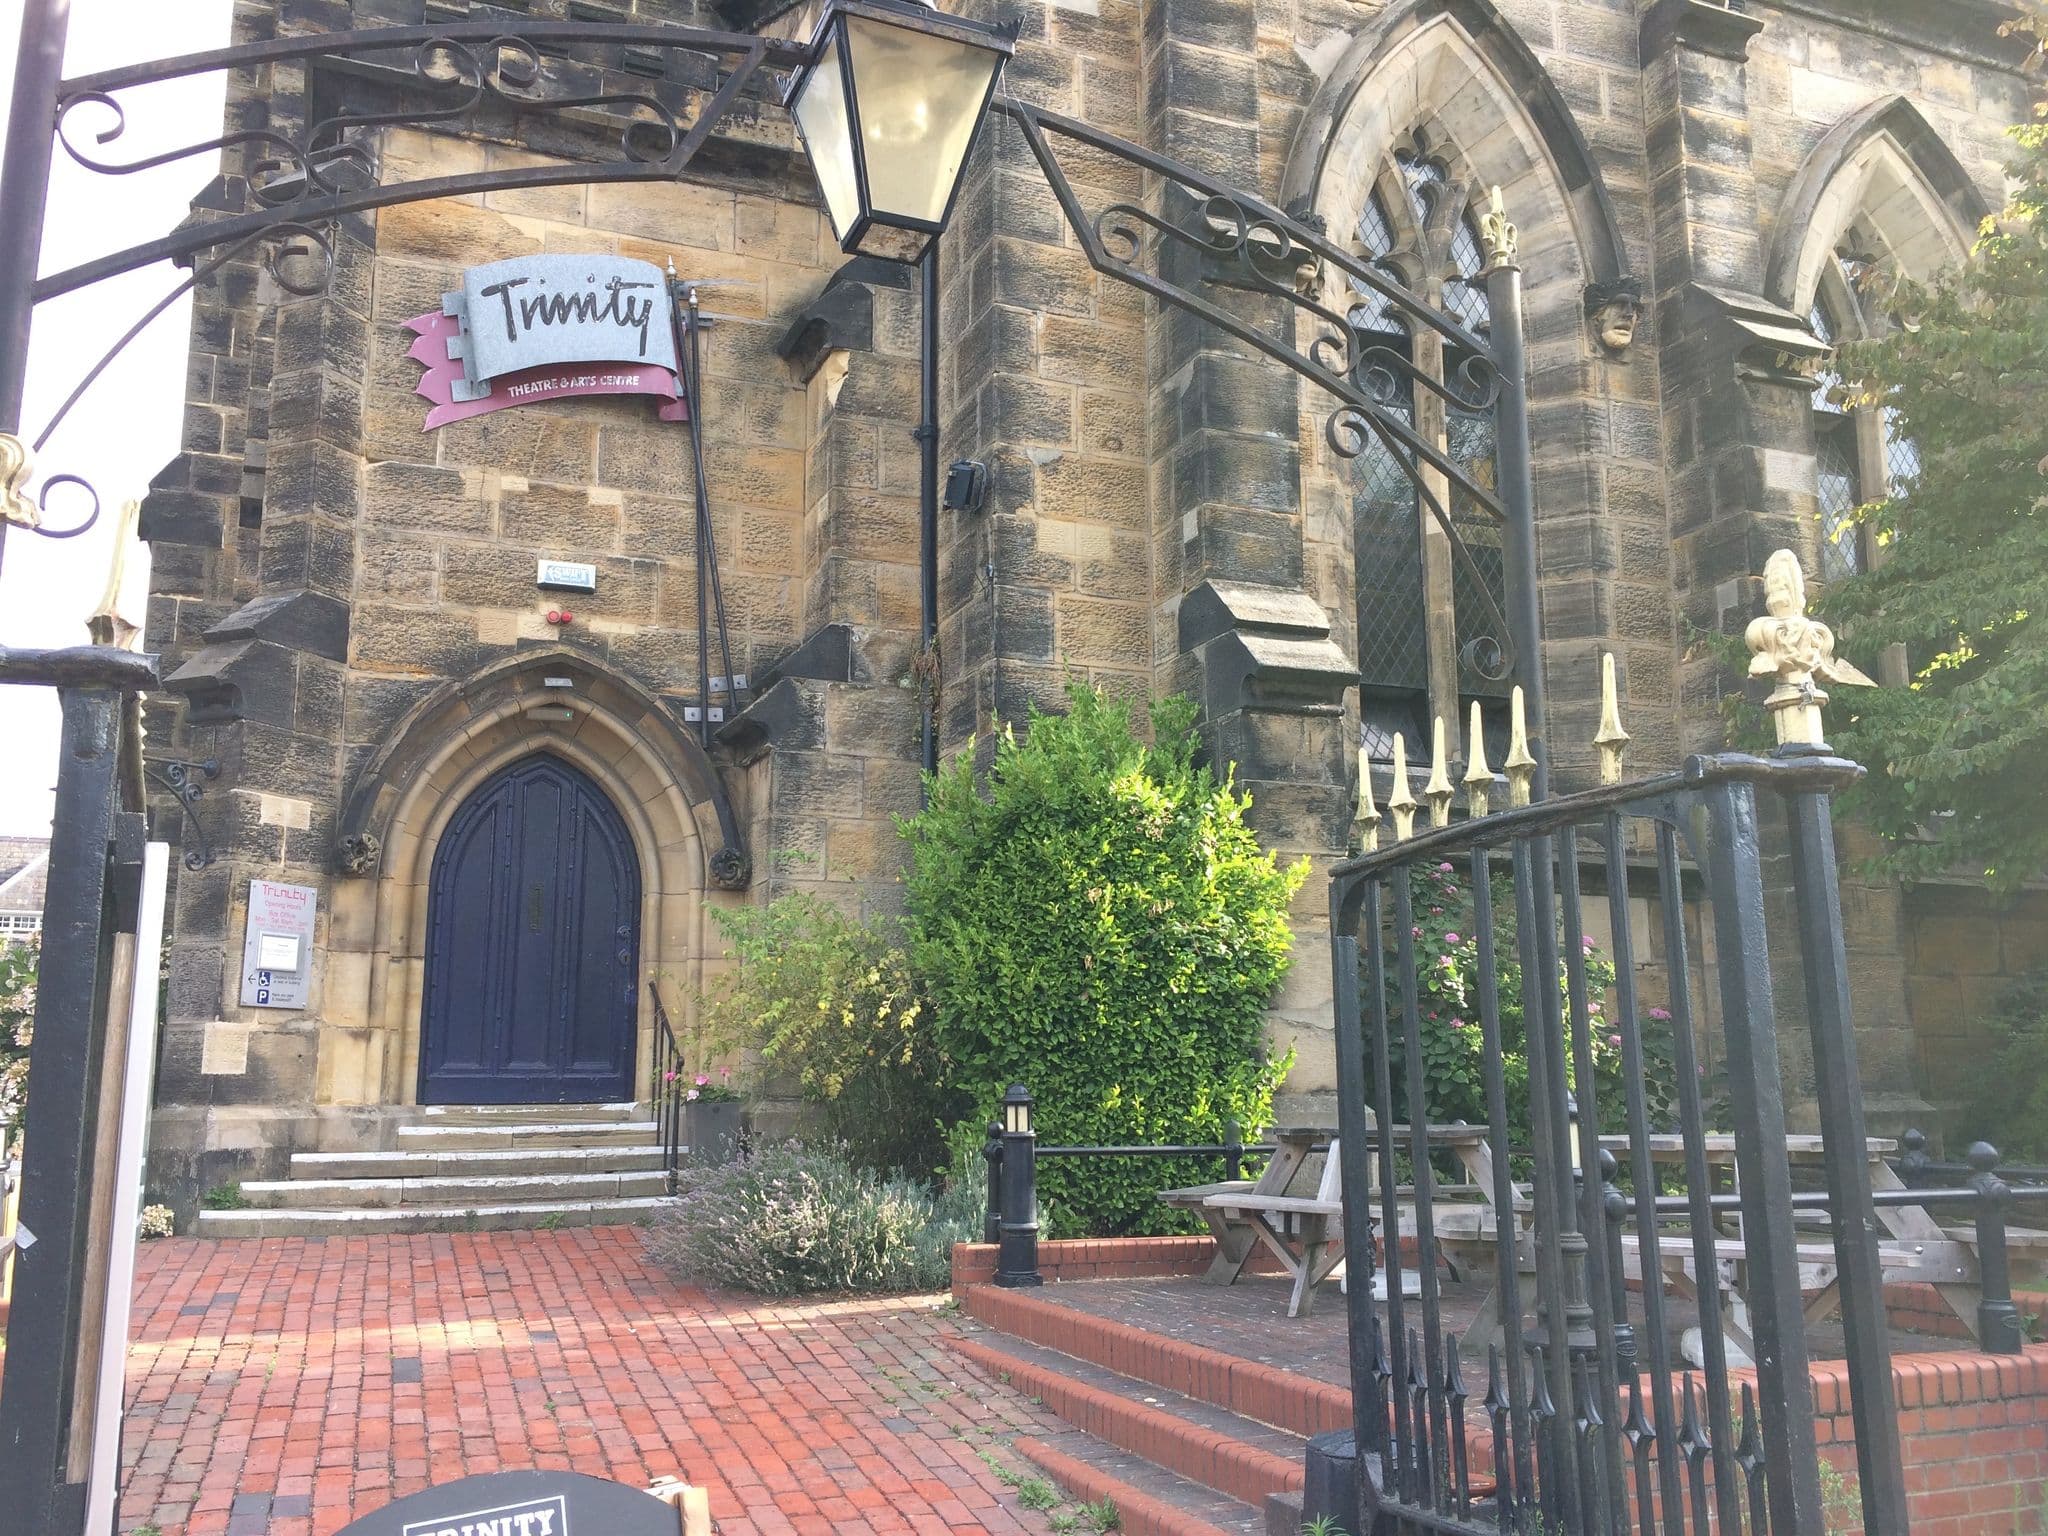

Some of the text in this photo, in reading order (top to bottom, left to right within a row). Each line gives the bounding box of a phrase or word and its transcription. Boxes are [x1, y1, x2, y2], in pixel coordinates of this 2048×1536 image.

[481, 273, 657, 356] Trinity
[507, 375, 640, 398] THEATRE & ARTS CENTRE
